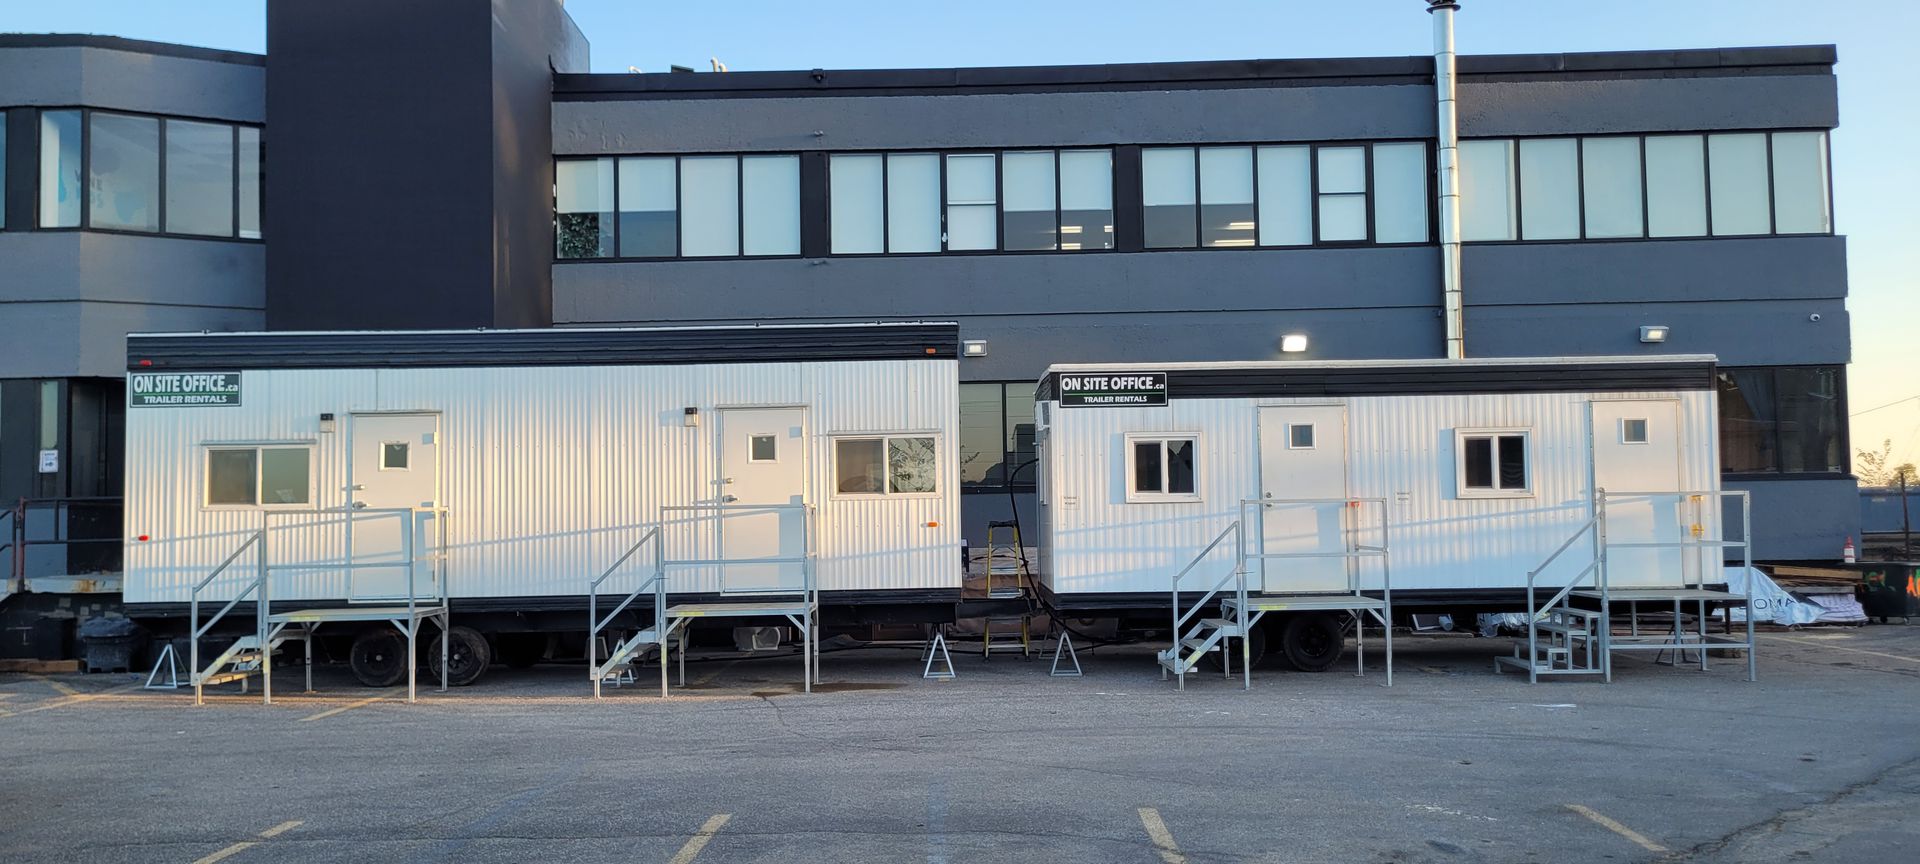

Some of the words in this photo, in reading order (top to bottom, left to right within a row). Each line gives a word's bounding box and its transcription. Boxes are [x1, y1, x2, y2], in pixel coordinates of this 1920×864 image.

[134, 375, 153, 393] ON
[155, 375, 180, 393] SITE
[1062, 377, 1081, 391] ON
[1083, 377, 1109, 391] SITE
[144, 396, 183, 404] TRAILER
[184, 395, 228, 404] RENTALS
[1083, 396, 1114, 404] TRAILER
